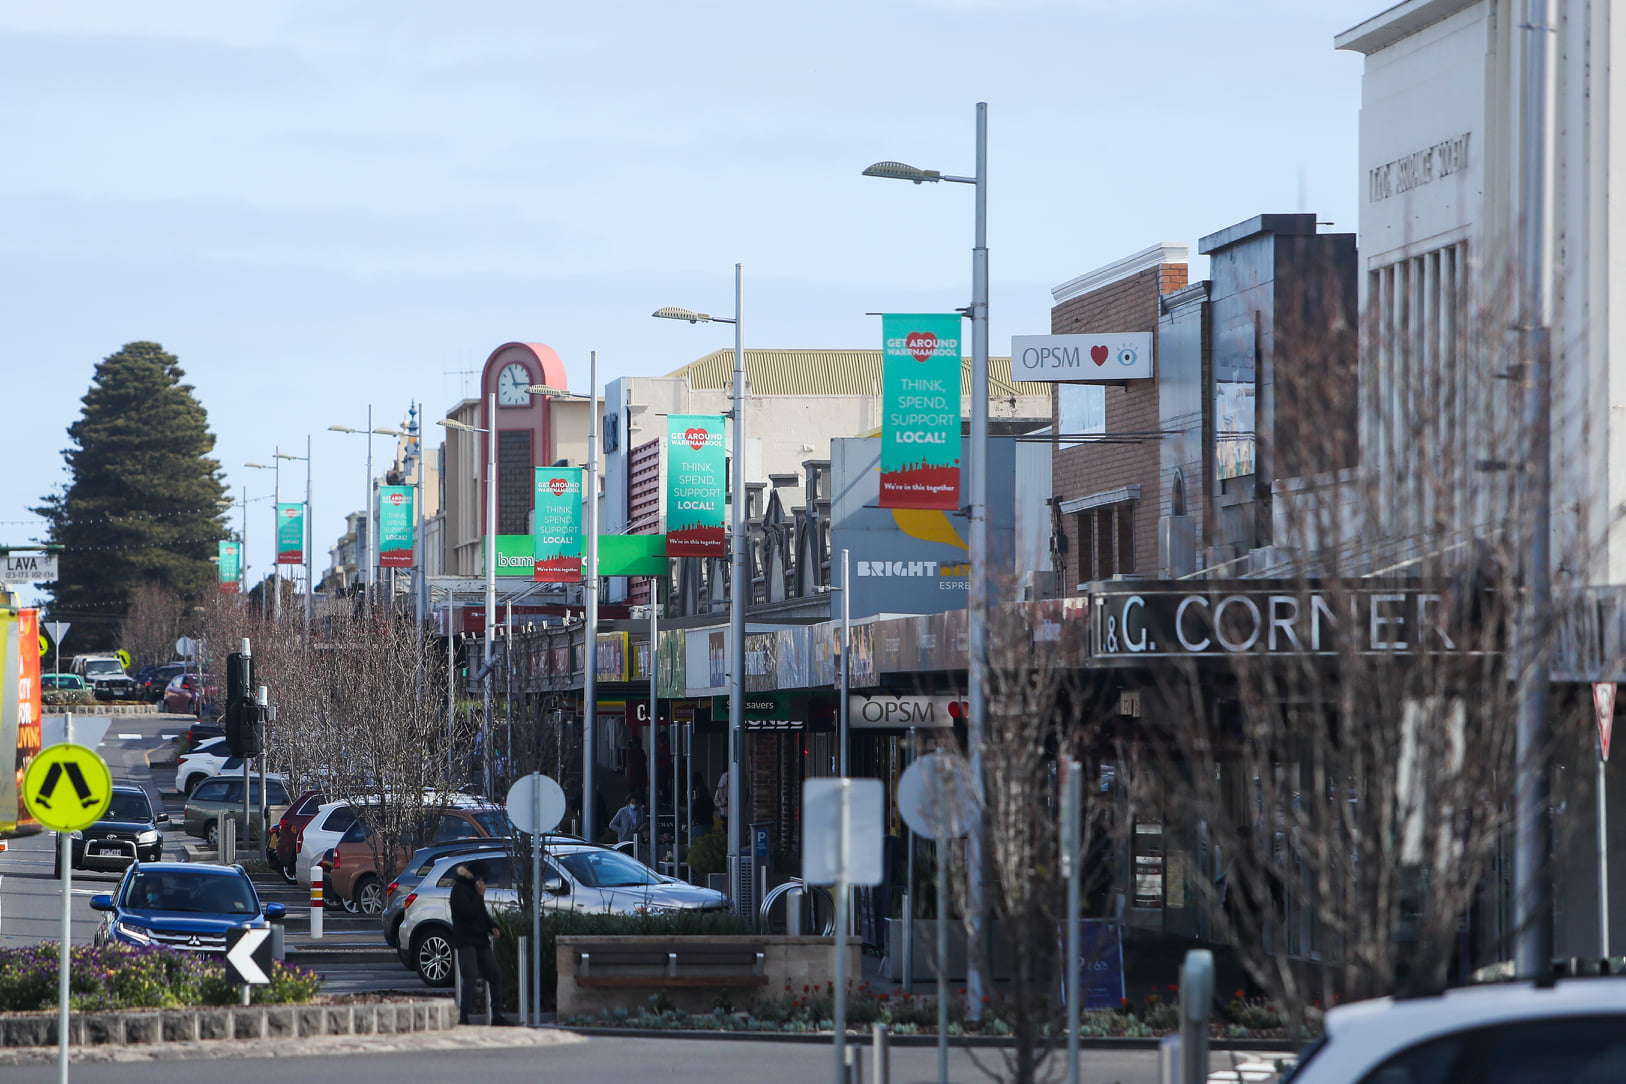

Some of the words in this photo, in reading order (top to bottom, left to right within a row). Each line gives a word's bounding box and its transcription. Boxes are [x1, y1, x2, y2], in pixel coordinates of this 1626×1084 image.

[886, 338, 907, 348] GET
[909, 338, 958, 348] AROUND
[1022, 347, 1080, 368] OPSM
[900, 378, 946, 392] THINK,
[898, 396, 948, 410] SPEND,
[891, 414, 955, 426] SUPPORT
[896, 432, 946, 444] LOCAL!
[682, 462, 714, 473] THINK,
[680, 475, 716, 486] SPEND,
[674, 488, 721, 498] SUPPORT
[926, 484, 954, 493] together
[677, 501, 715, 510] LOCAL!
[8, 558, 37, 570] LAVA
[857, 562, 936, 576] BRIGHT
[862, 702, 935, 722] OPSM
[758, 832, 766, 842] P
